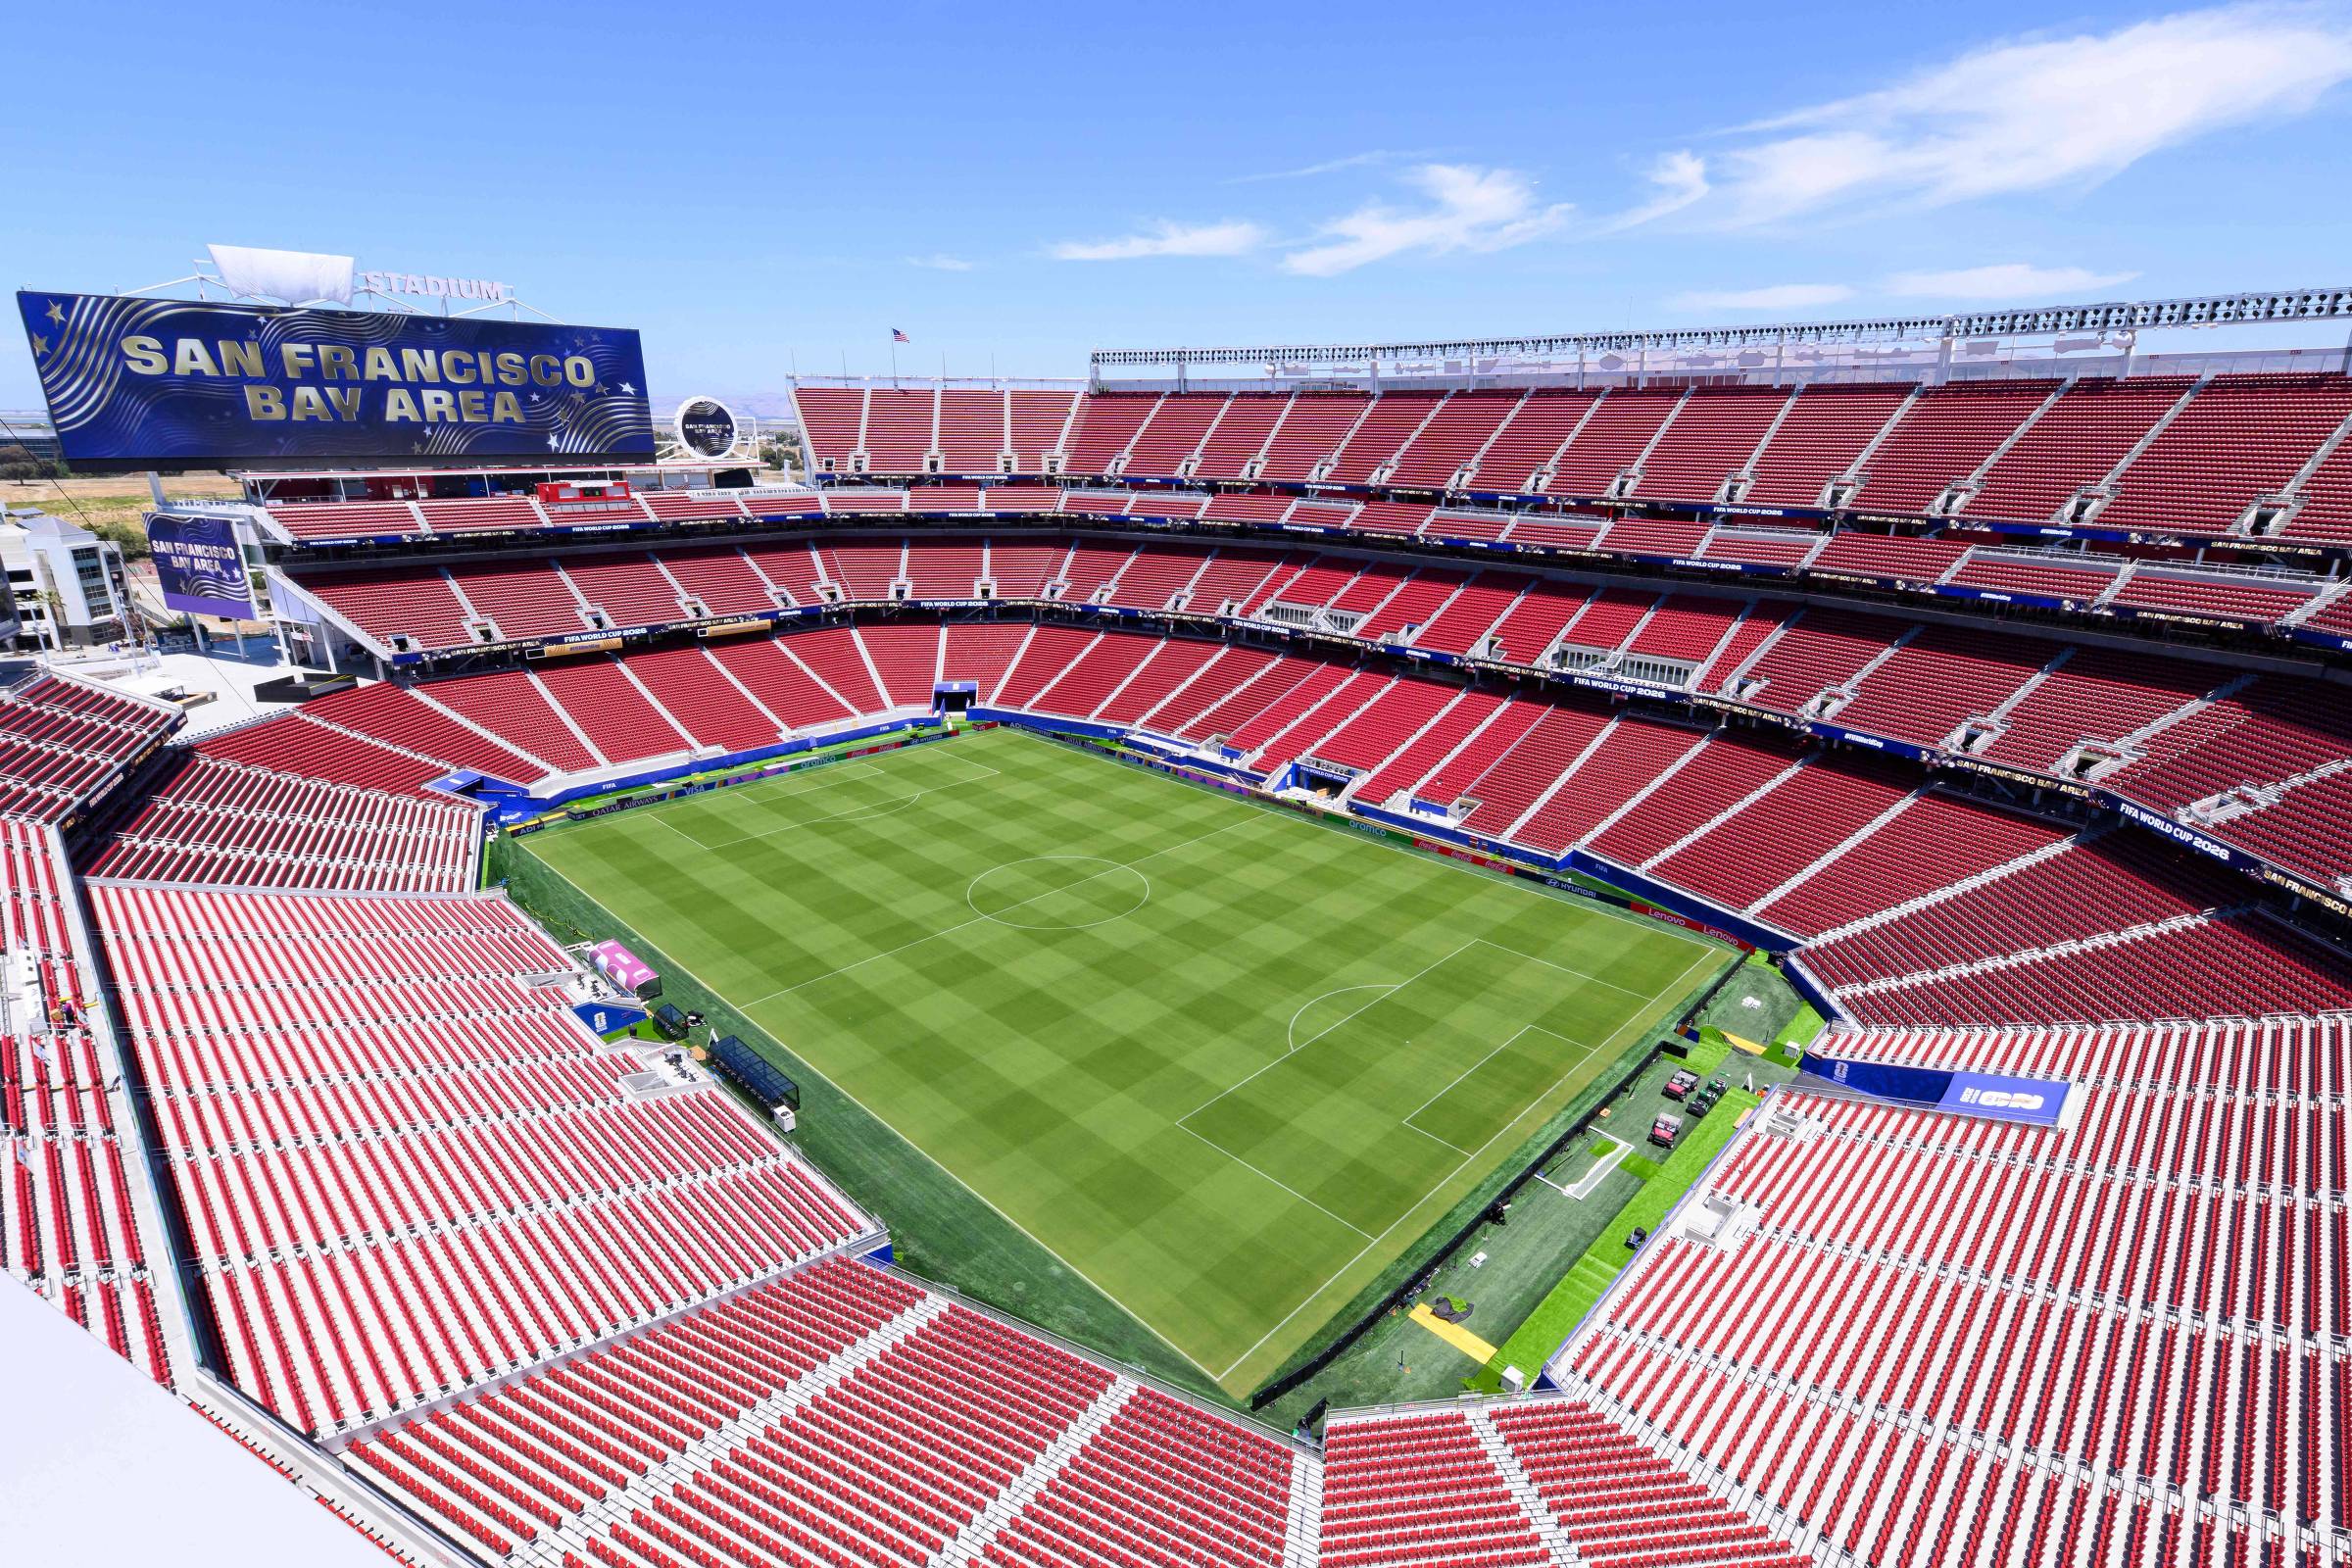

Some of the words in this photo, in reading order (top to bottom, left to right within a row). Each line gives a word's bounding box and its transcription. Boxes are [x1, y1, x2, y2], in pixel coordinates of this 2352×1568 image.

[365, 271, 504, 301] STADIUM
[121, 336, 266, 377] SAN
[281, 343, 595, 388] FRANCISCO
[244, 385, 362, 421] BAY
[385, 388, 526, 423] AREA
[152, 540, 174, 554] SAN
[174, 543, 235, 560] FRANCISCO
[2229, 543, 2278, 552] FRANCISCO
[171, 556, 191, 568] BAY
[194, 558, 223, 572] AREA
[1243, 621, 1261, 630] WORLD
[1272, 626, 1289, 635] 2026
[2154, 614, 2201, 625] FRANCISCO
[2220, 621, 2244, 629] AREA
[581, 632, 607, 641] WORLD
[623, 627, 647, 636] 2026
[1534, 670, 1550, 678] AREA
[1574, 677, 1590, 686] FIFA
[1591, 679, 1618, 691] WORLD
[1620, 684, 1636, 694] CUP
[1637, 687, 1666, 698] 2026
[1693, 696, 1708, 706] SAN
[1709, 700, 1747, 715] FRANCISCO
[1748, 709, 1762, 719] BAY
[1762, 713, 1782, 723] AREA
[800, 756, 835, 769] aramco
[1152, 761, 1165, 770] VISA
[1310, 768, 1324, 776] WORLD
[1957, 760, 1977, 770] SAN
[1978, 765, 2036, 784] FRANCISCO
[2037, 778, 2059, 789] BAY
[2060, 784, 2089, 798] AREA
[684, 784, 705, 795] VISA
[592, 805, 621, 816] QATAR
[624, 796, 658, 808] AIRWAYS
[1349, 820, 1387, 837] aramco
[2120, 803, 2139, 819] FIFA
[2139, 809, 2173, 833] WORLD
[2173, 827, 2193, 843] CUP
[2193, 836, 2229, 860] 2026
[1595, 863, 1608, 874] FIFA
[1560, 883, 1596, 898] HYUNDAI
[2264, 869, 2286, 886] SAN
[2285, 880, 2347, 914] FRANCISCO
[1649, 908, 1686, 926] Lenovo
[1703, 925, 1738, 946] Lenovo
